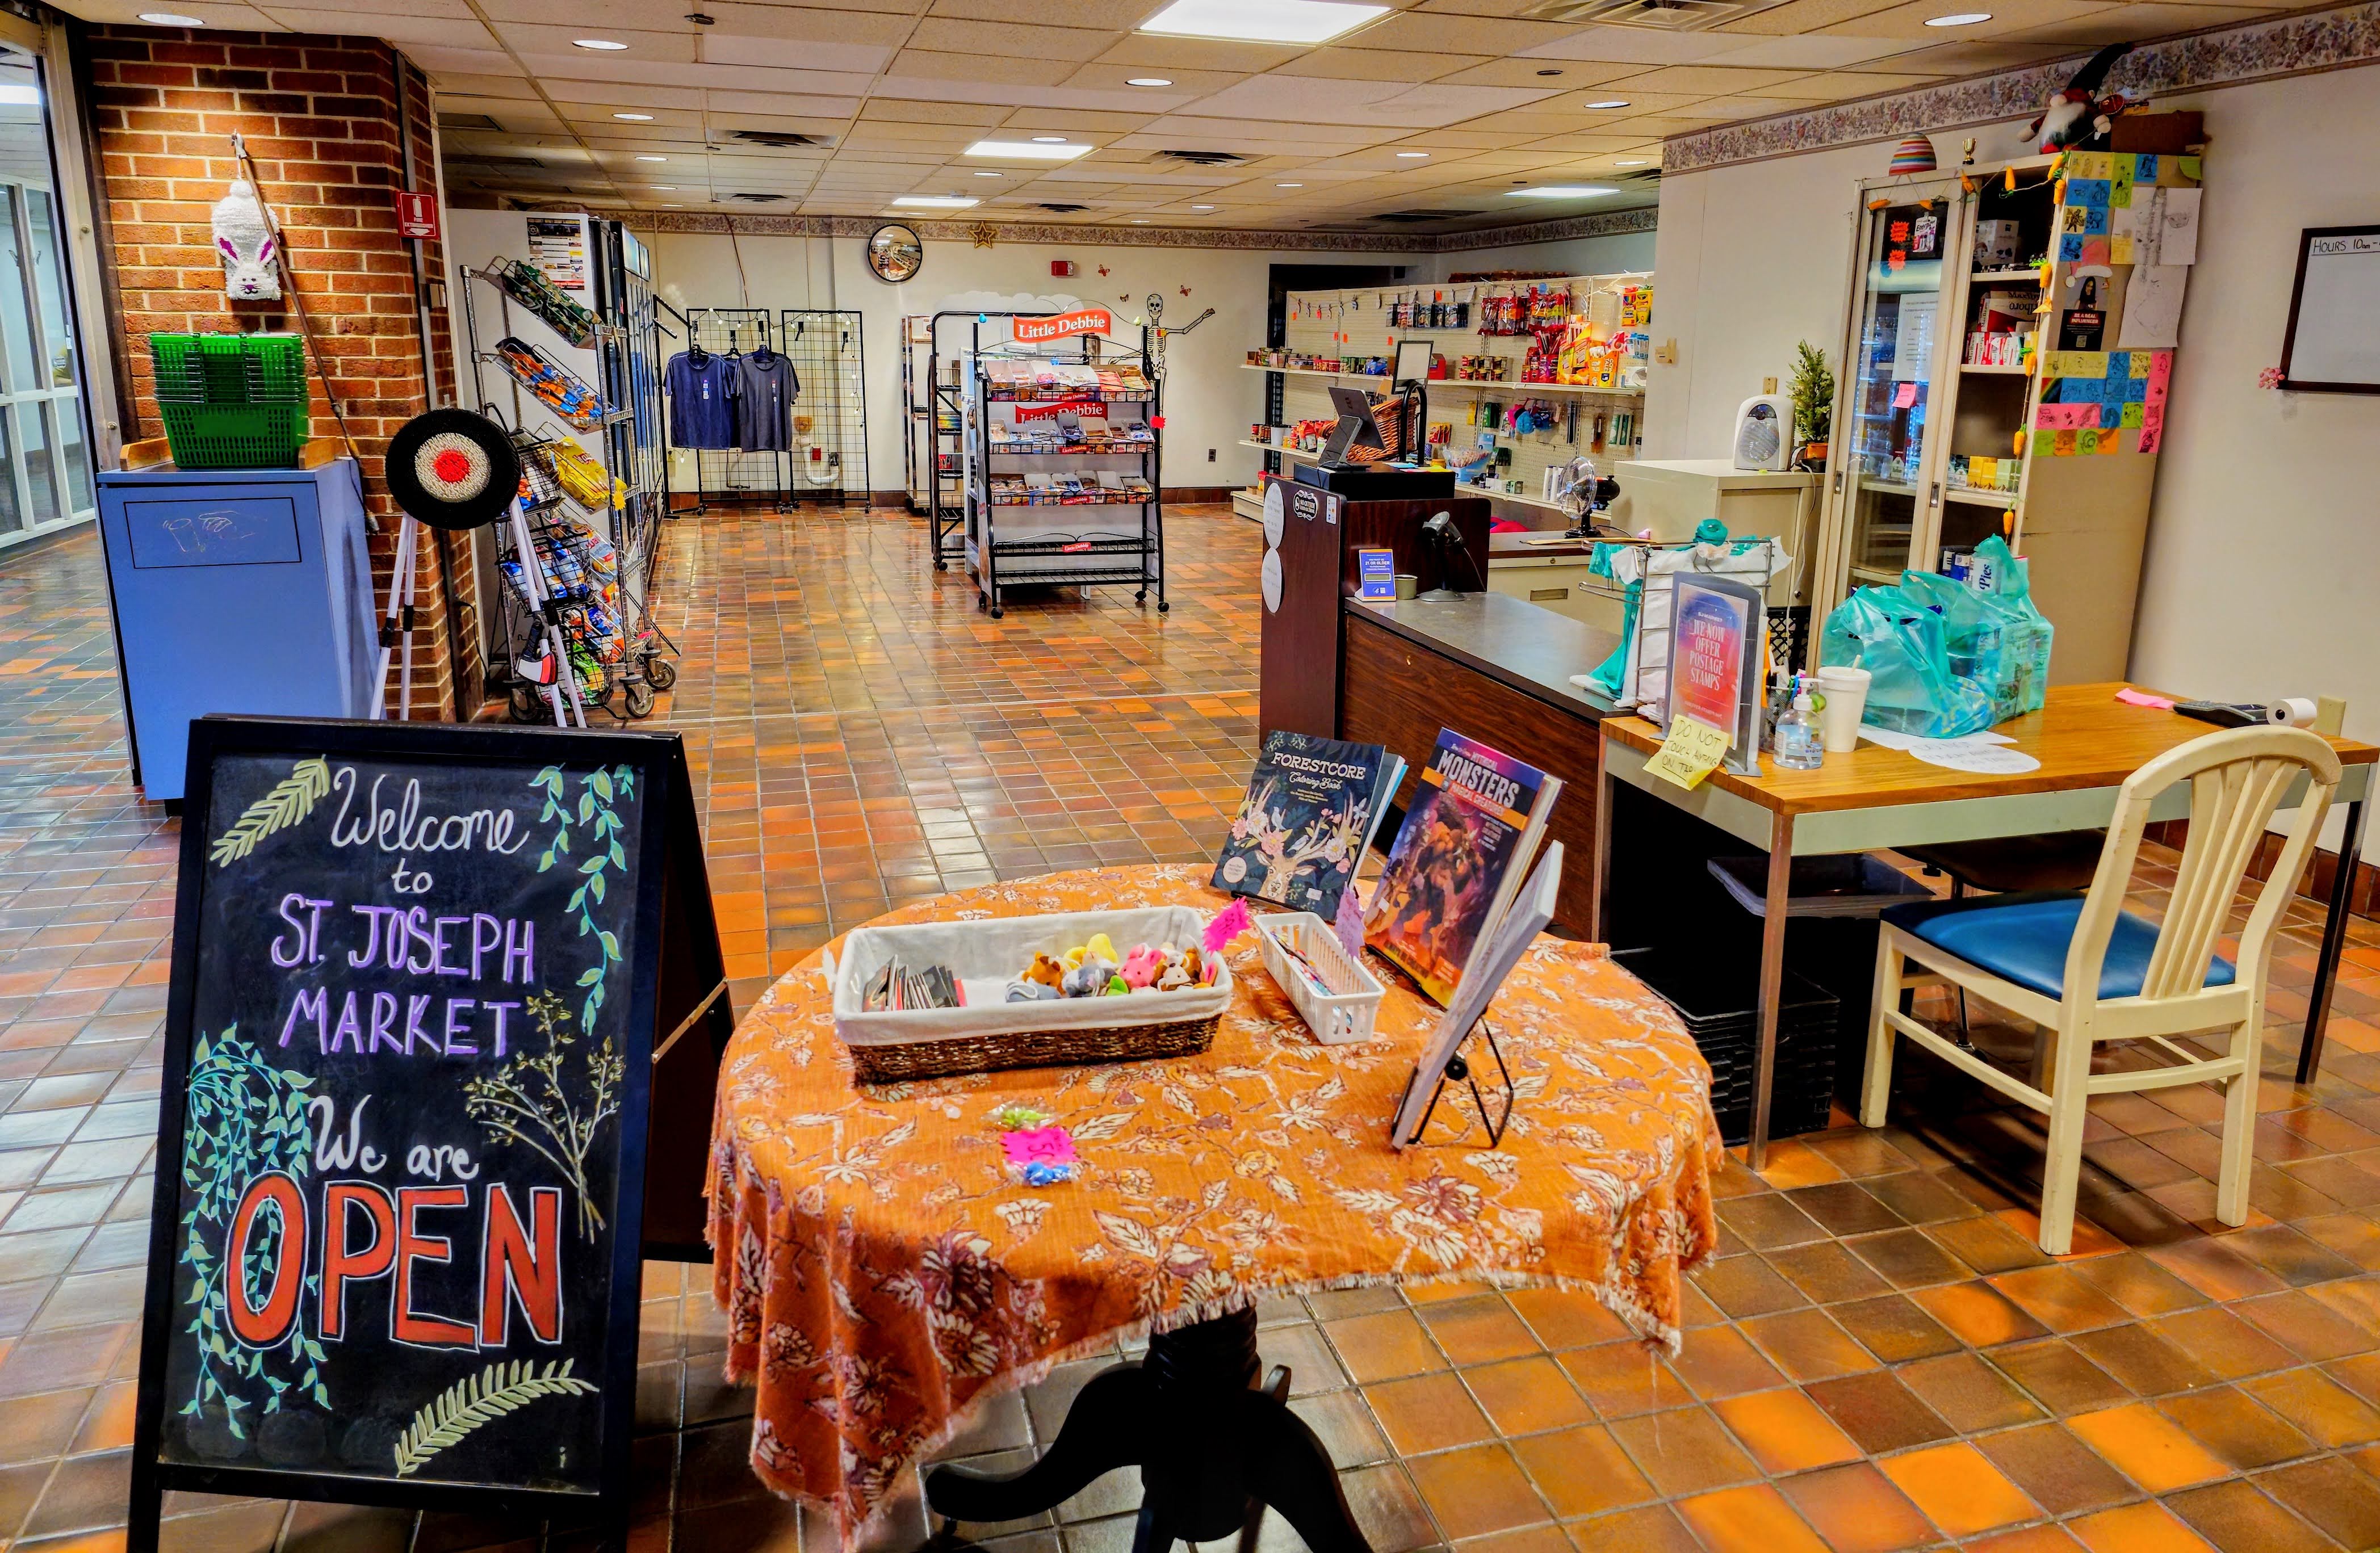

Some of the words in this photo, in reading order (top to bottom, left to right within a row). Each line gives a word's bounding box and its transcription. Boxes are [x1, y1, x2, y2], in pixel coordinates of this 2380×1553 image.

[2313, 239, 2347, 253] HOURS
[2353, 238, 2370, 250] 10am
[1018, 324, 1055, 338] Little
[1058, 315, 1105, 333] Debbie
[1979, 564, 1991, 590] Pies
[1694, 619, 1707, 637] WE
[1706, 624, 1725, 643] NOW
[1695, 638, 1720, 658] OFFER
[1690, 650, 1724, 676] POSTAGE
[1691, 669, 1720, 691] STAMPS
[1676, 720, 1691, 737] DO
[1697, 729, 1721, 748] NOT
[1662, 754, 1674, 767] ON
[1666, 740, 1690, 755] TOUCH
[1271, 752, 1366, 780] FORESTCORE
[1435, 749, 1520, 808] MONSTERS
[1289, 771, 1320, 790] Coloring
[1319, 777, 1343, 790] Book
[330, 766, 532, 854] Welcome
[392, 858, 433, 895] to
[271, 893, 334, 970] ST.
[349, 904, 535, 985] JOSEPH
[278, 990, 520, 1057] MARKET
[309, 1093, 387, 1170] We
[407, 1143, 480, 1181] are
[225, 1169, 563, 1353] OPEN
